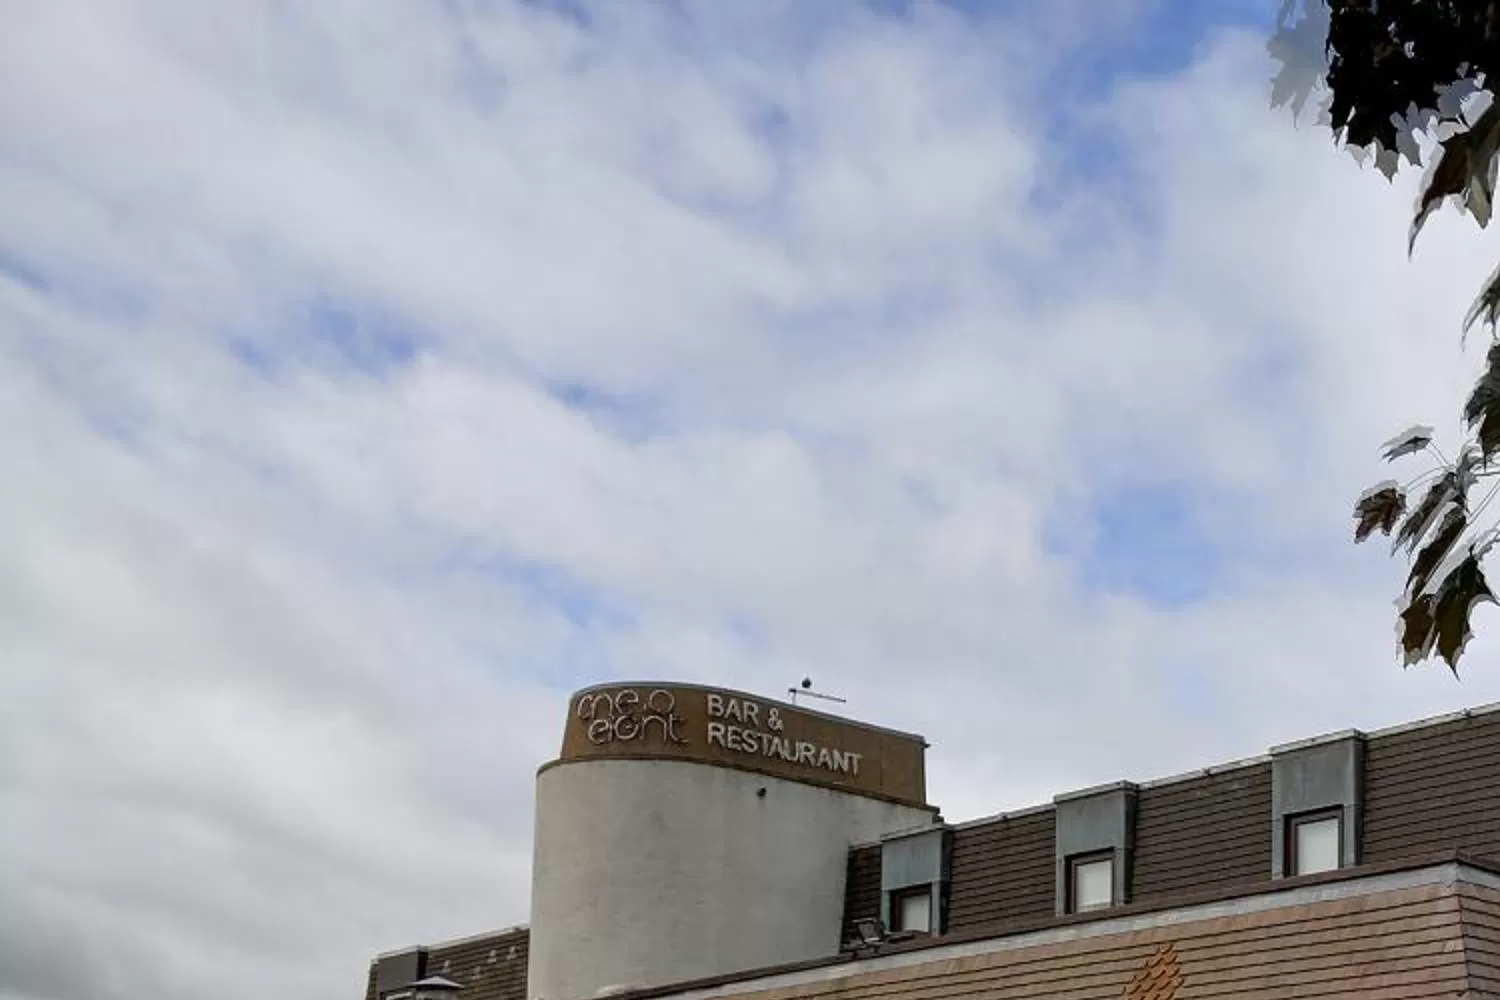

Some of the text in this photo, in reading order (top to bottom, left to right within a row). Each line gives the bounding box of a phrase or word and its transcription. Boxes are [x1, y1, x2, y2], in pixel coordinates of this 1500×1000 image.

[706, 693, 784, 731] BAR &
[707, 722, 863, 775] RESTAURANT
